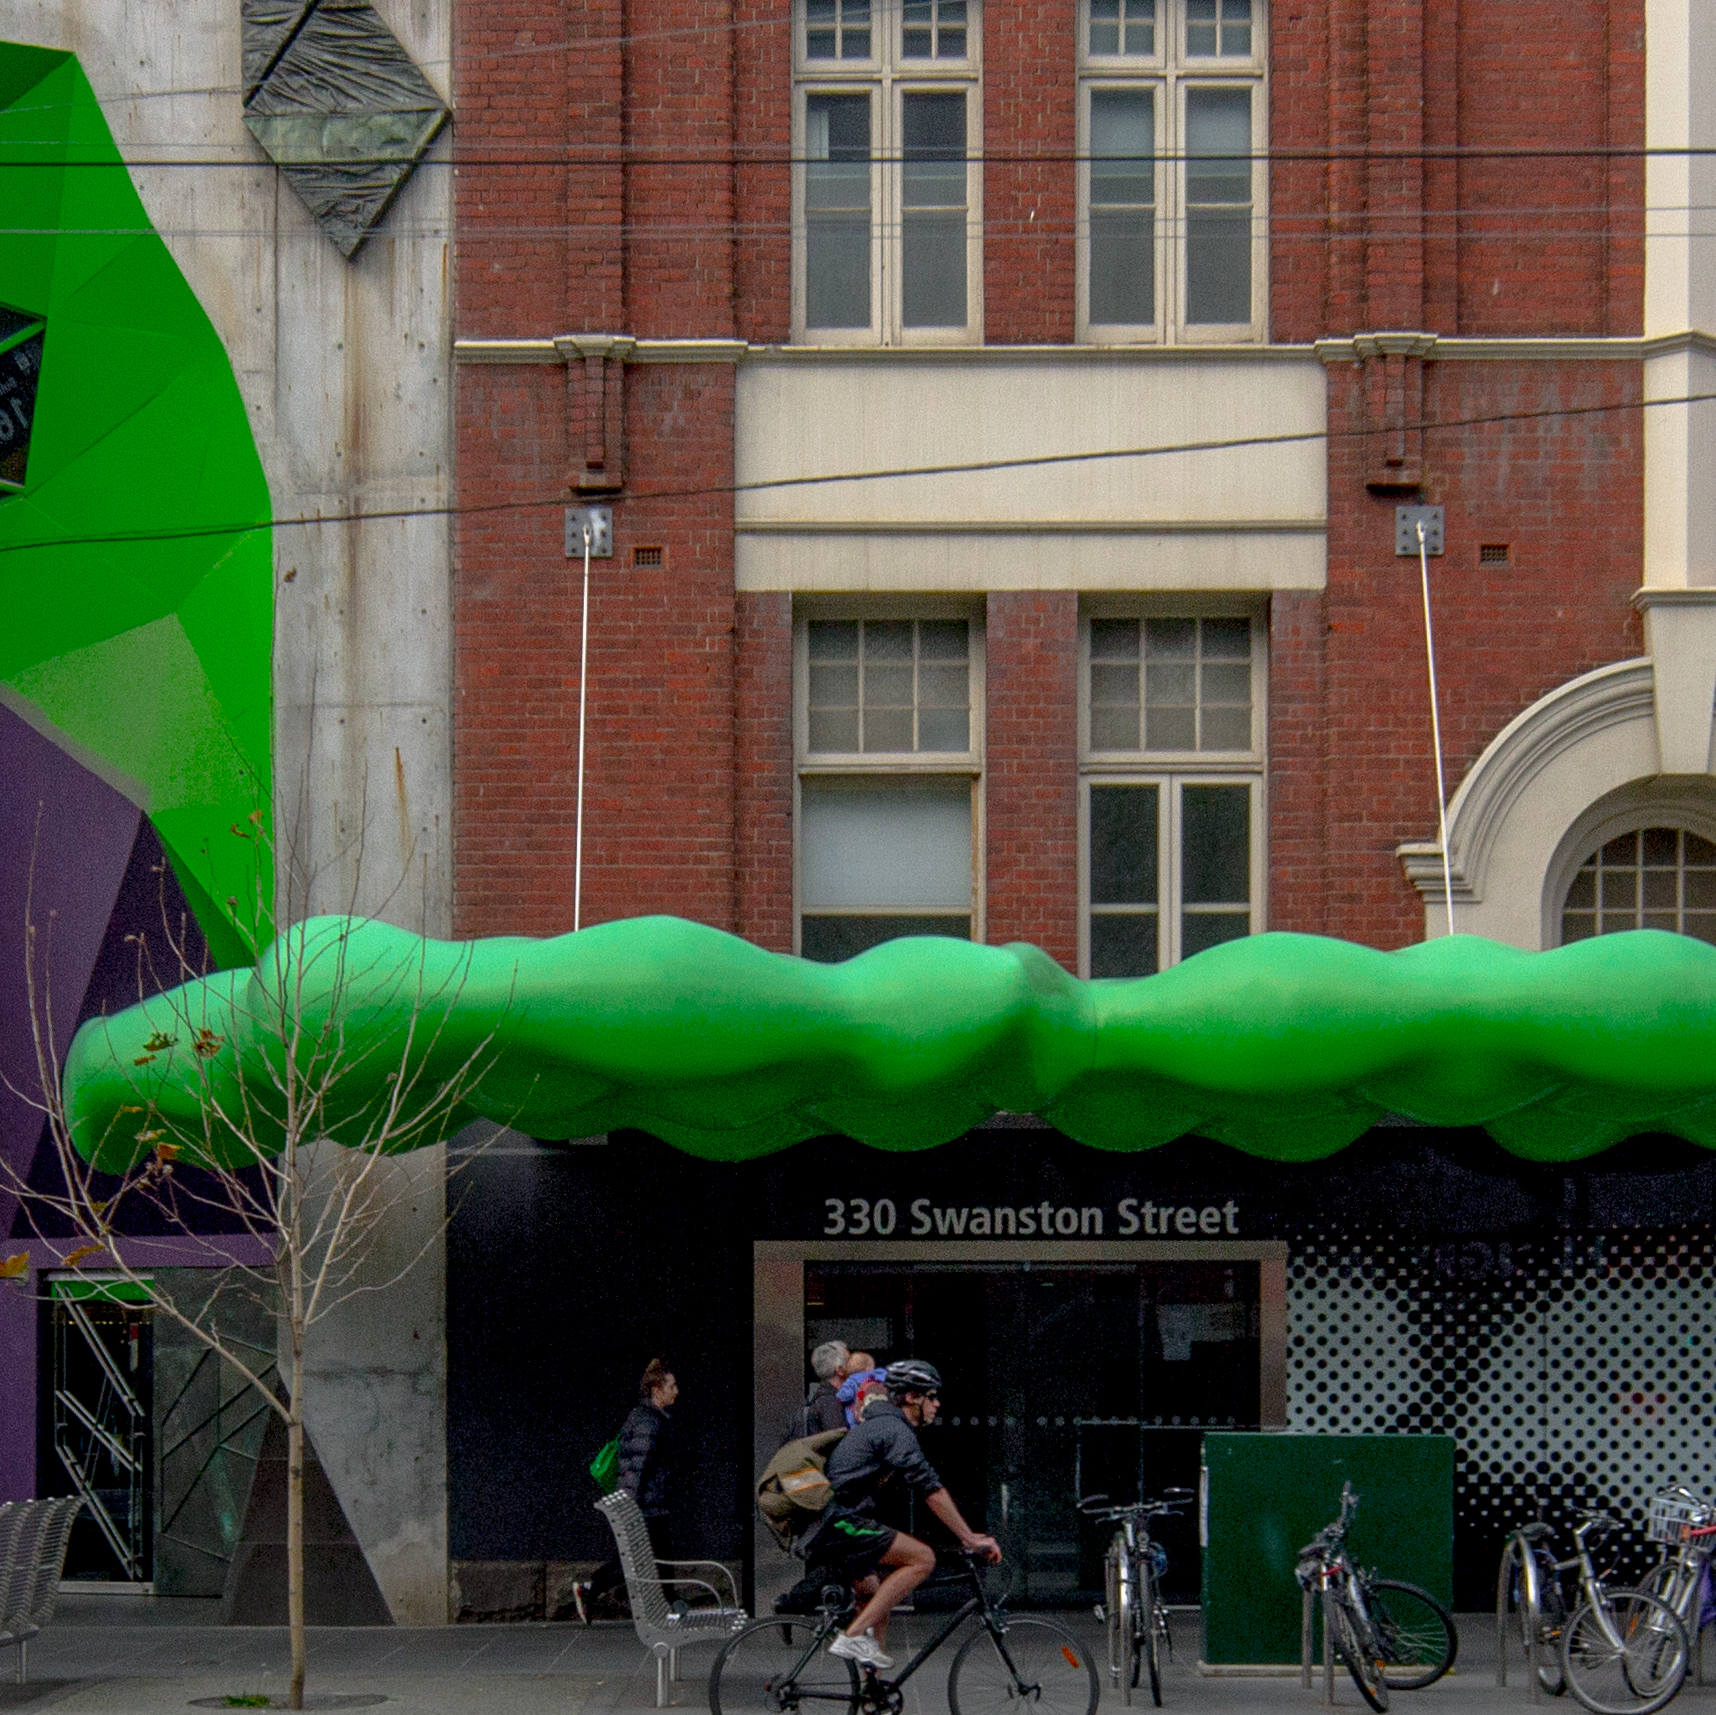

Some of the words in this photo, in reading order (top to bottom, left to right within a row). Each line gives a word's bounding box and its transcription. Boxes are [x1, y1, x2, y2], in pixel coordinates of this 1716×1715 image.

[822, 1196, 898, 1236] 330
[909, 1196, 1105, 1237] Swanston
[1117, 1196, 1241, 1237] Street
